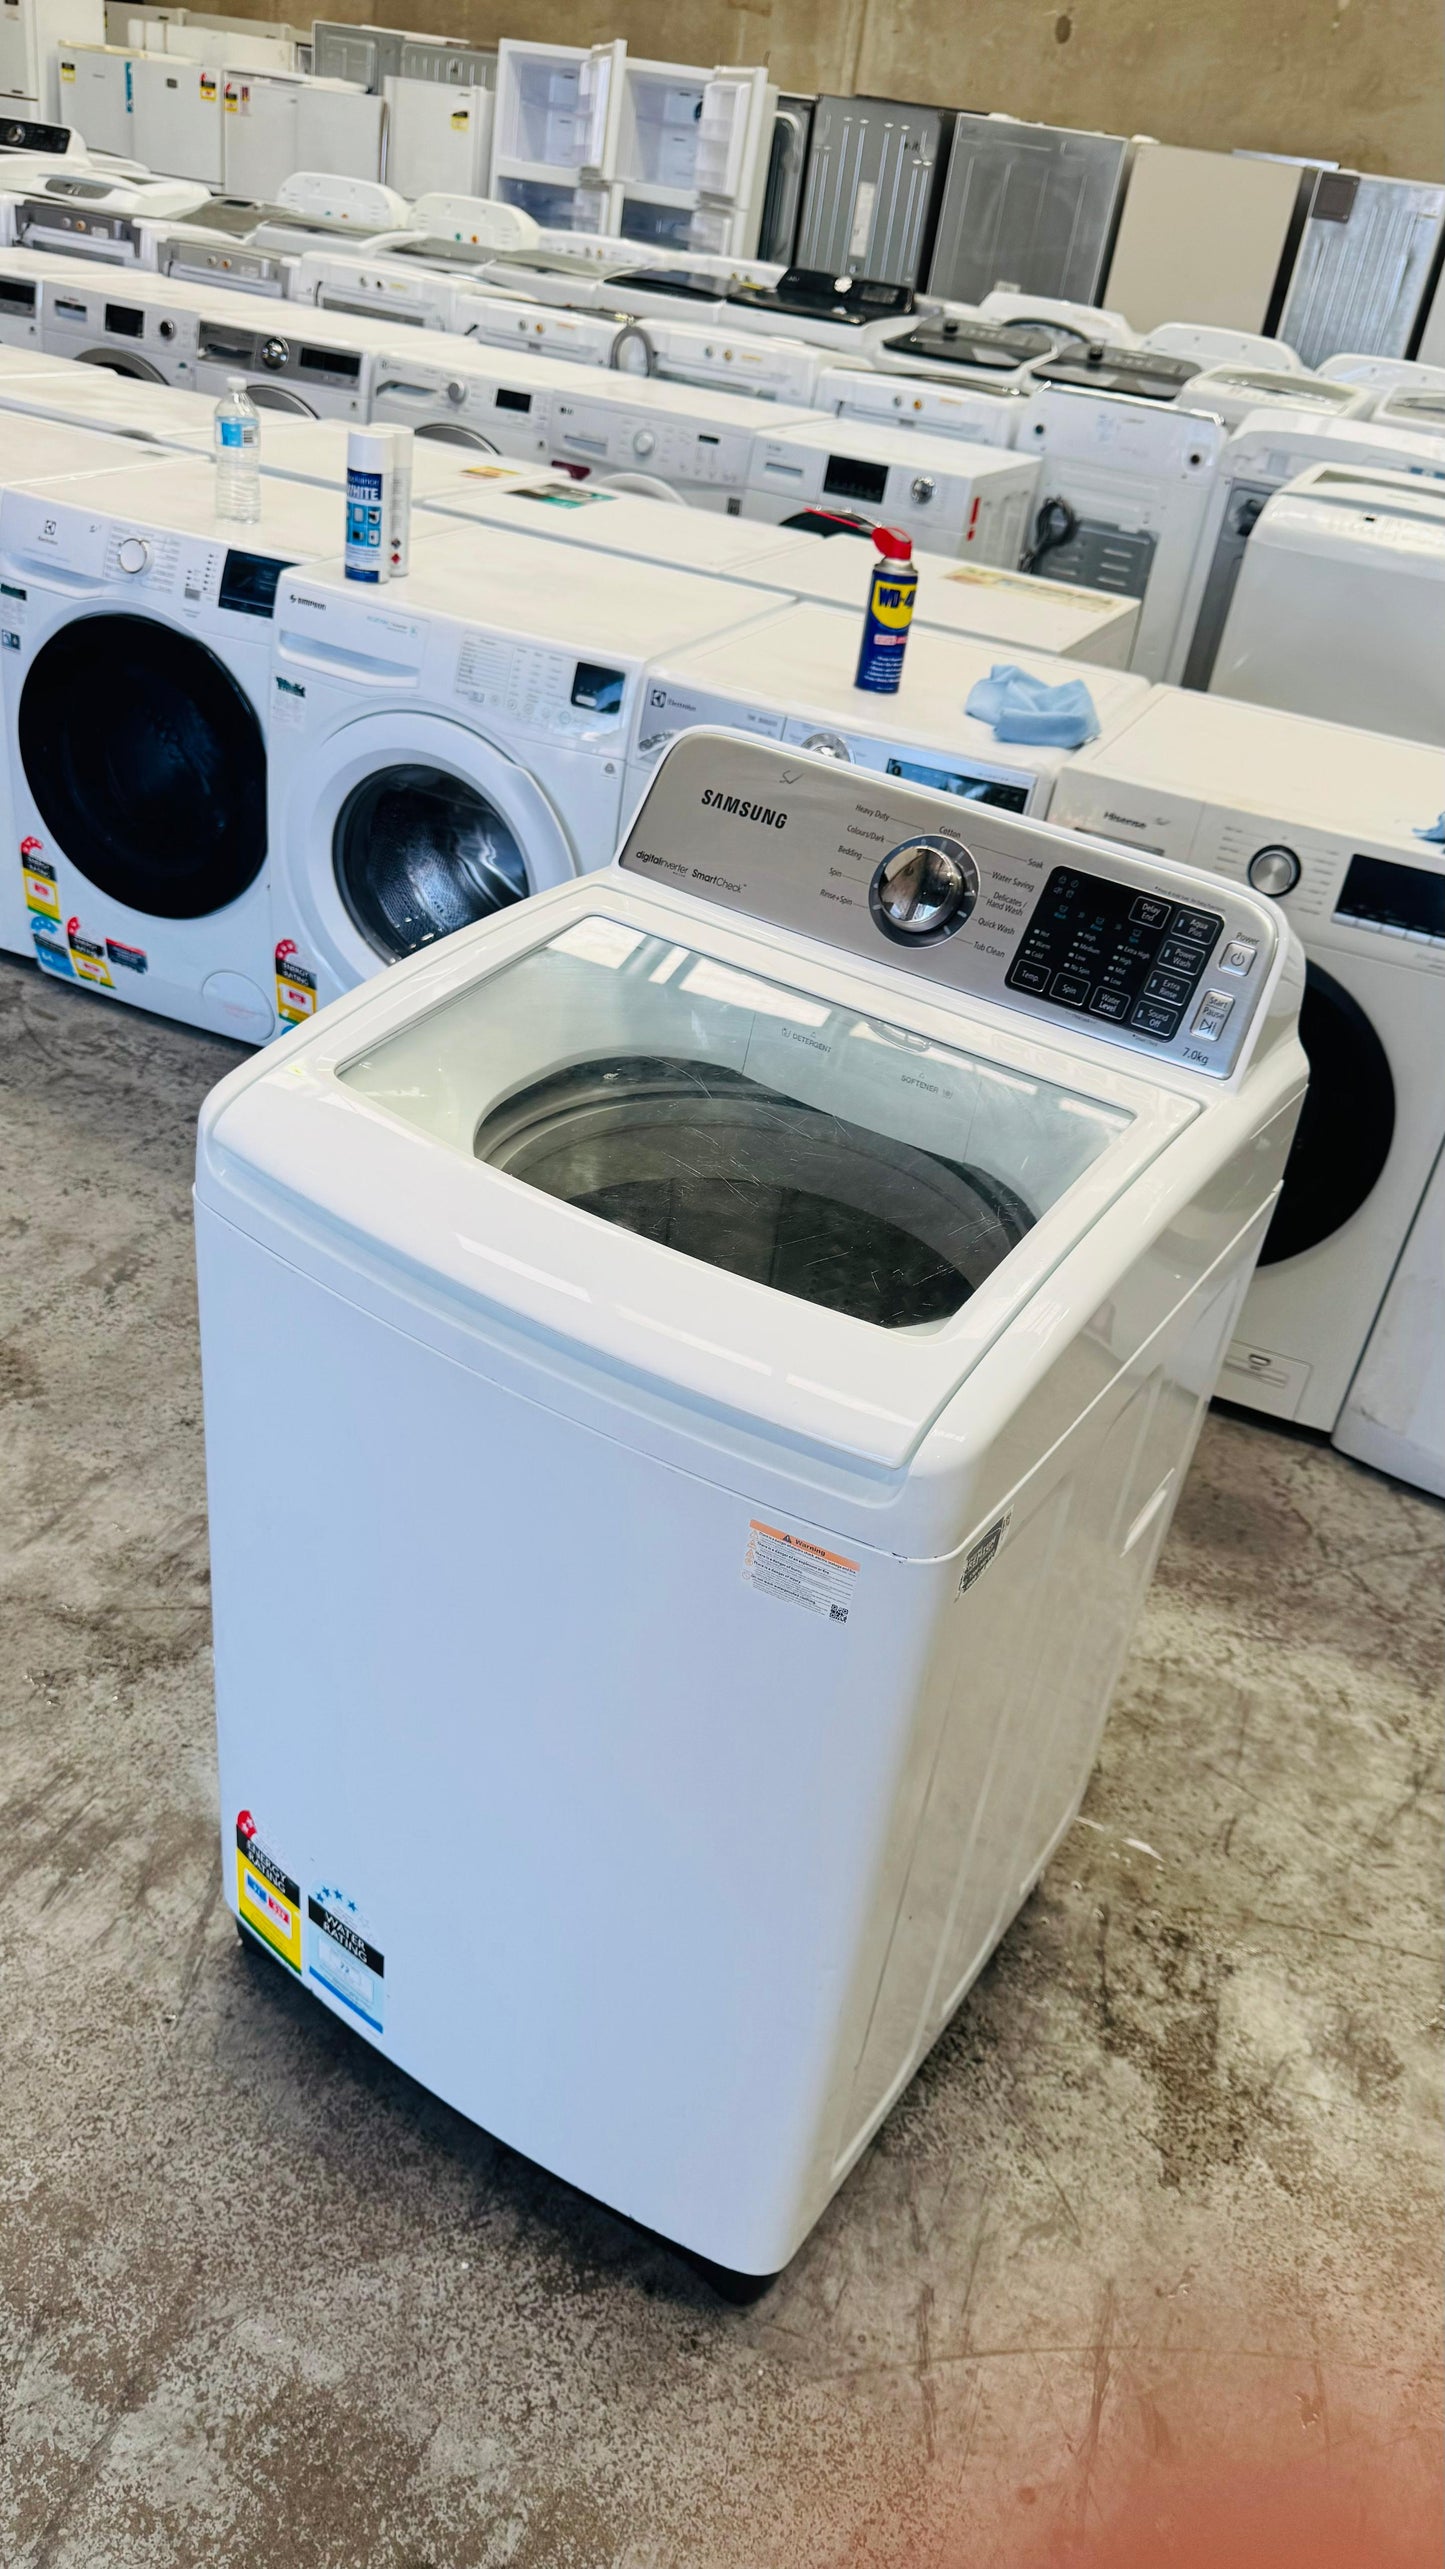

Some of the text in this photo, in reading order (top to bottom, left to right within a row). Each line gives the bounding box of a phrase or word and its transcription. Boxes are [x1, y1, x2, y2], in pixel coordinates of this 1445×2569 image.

[879, 587, 916, 609] WD-4
[701, 789, 788, 829] SAMSUNG
[855, 804, 890, 821] Heavy Duty
[846, 825, 885, 843] Colours/Dark
[939, 826, 961, 839] Cotton
[838, 845, 863, 860] Bedding
[1027, 858, 1043, 869] Soak
[829, 867, 843, 877] Spin
[992, 871, 1035, 892] Water Saving
[993, 891, 1022, 907] Delicates
[986, 898, 1024, 916] Hand Wash
[1141, 902, 1161, 917] Delay
[1141, 911, 1156, 922] End
[977, 917, 1015, 936] Quick Wash
[1190, 918, 1208, 930] Aqua
[1083, 932, 1097, 942] High
[1187, 926, 1203, 938] Plus
[1235, 931, 1260, 945] Power
[973, 941, 1005, 958] Tub Clean
[1030, 950, 1045, 959] Cold
[1079, 943, 1101, 955] Medium
[1123, 945, 1151, 960] Extra High
[1174, 947, 1197, 960] Power
[1074, 954, 1087, 962] Low
[1172, 955, 1192, 968] Wash
[1078, 966, 1091, 975] Spin
[1061, 983, 1078, 995] Spin
[1161, 978, 1181, 991] Extra
[1100, 993, 1120, 1004] Water
[1158, 986, 1178, 1000] Rinse
[1098, 1001, 1118, 1013] Level
[1208, 996, 1228, 1008] Start
[1147, 1008, 1169, 1023] Sound
[1202, 1006, 1225, 1019] Pause
[1148, 1017, 1161, 1028] Off
[792, 1032, 832, 1053] DETERGENT
[1182, 1047, 1210, 1067] 7.0kg
[901, 1074, 939, 1093] SOFTENER
[795, 1539, 826, 1557] Warning
[247, 1840, 287, 1882] ENERGY
[248, 1853, 286, 1894] RATING
[324, 1911, 366, 1952] WATER
[322, 1922, 368, 1963] RATING
